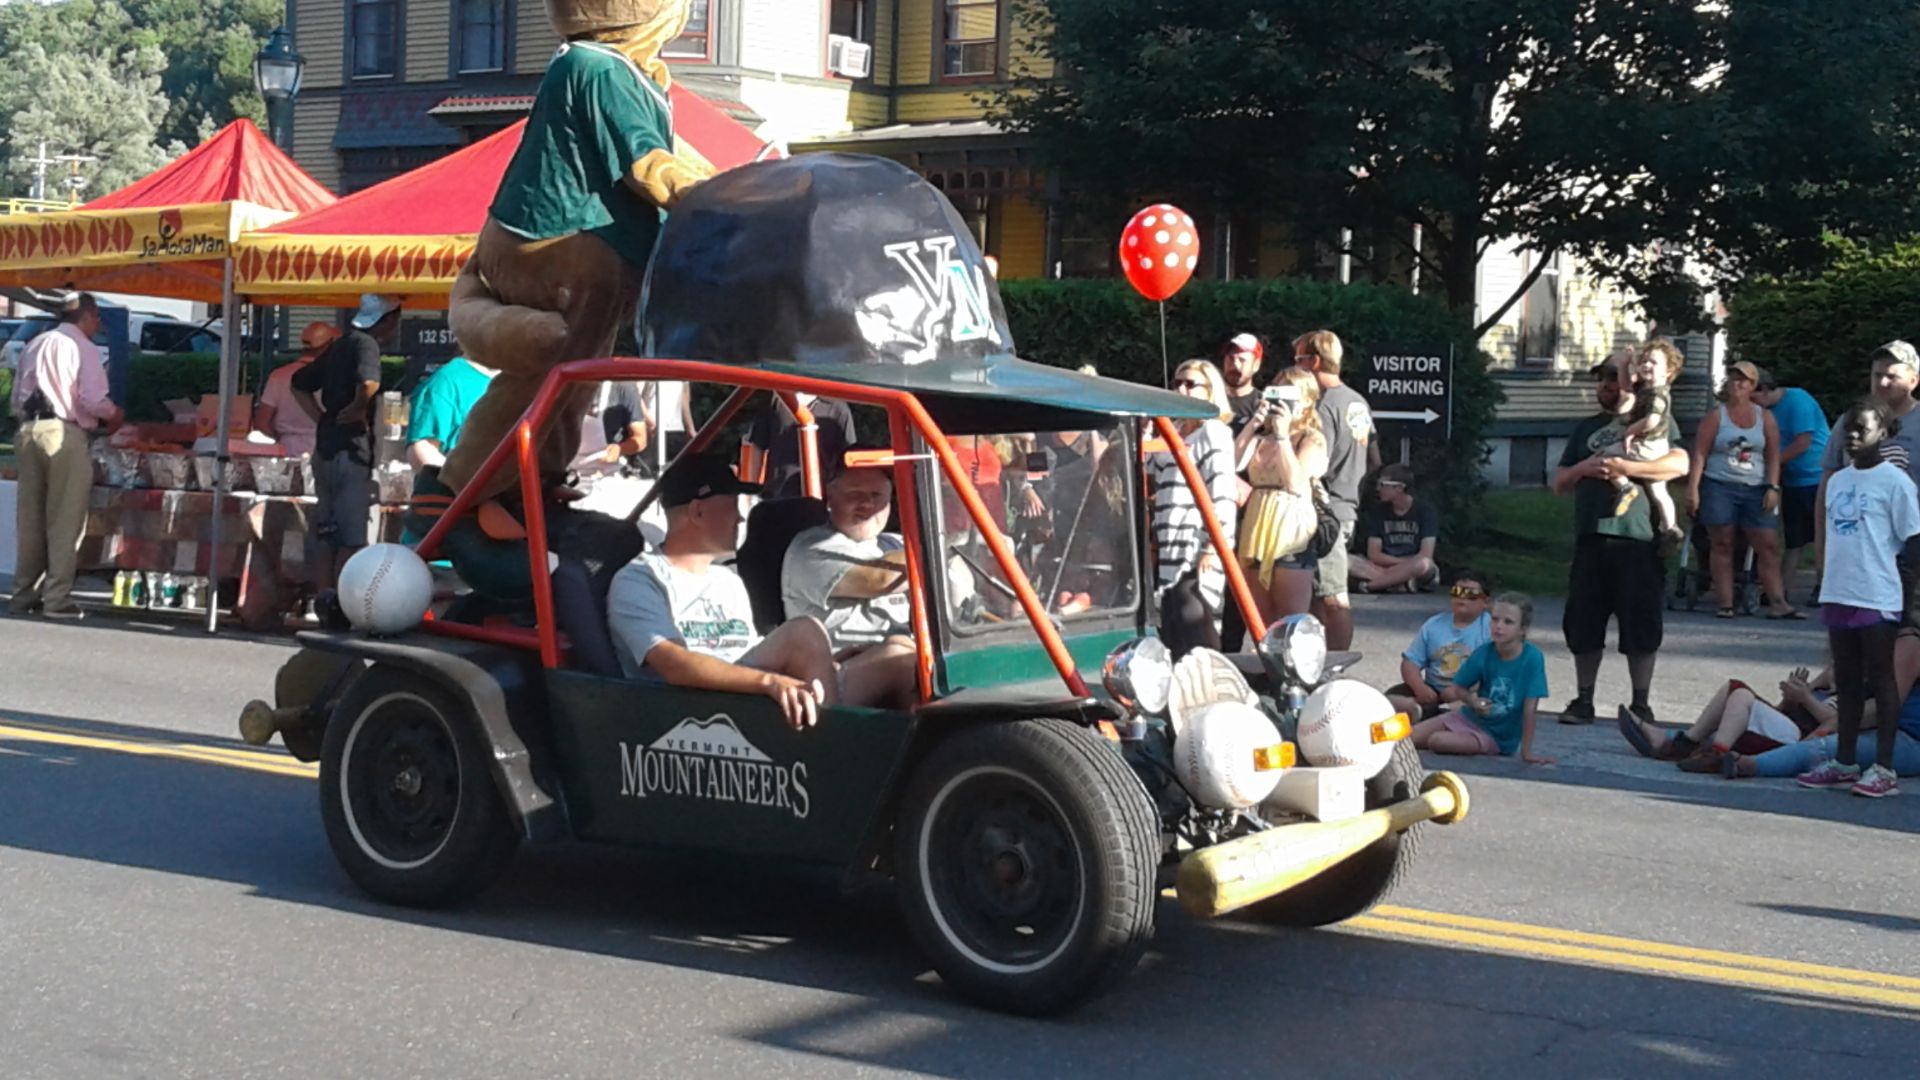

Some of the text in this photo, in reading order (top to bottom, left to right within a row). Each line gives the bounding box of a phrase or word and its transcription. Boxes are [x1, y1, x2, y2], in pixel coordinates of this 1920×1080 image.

[418, 329, 437, 344] 132
[1373, 355, 1442, 372] VISITOR
[1368, 378, 1445, 395] PARKING
[666, 738, 751, 757] VERMONT
[619, 741, 810, 819] MOUNTAINEERS
